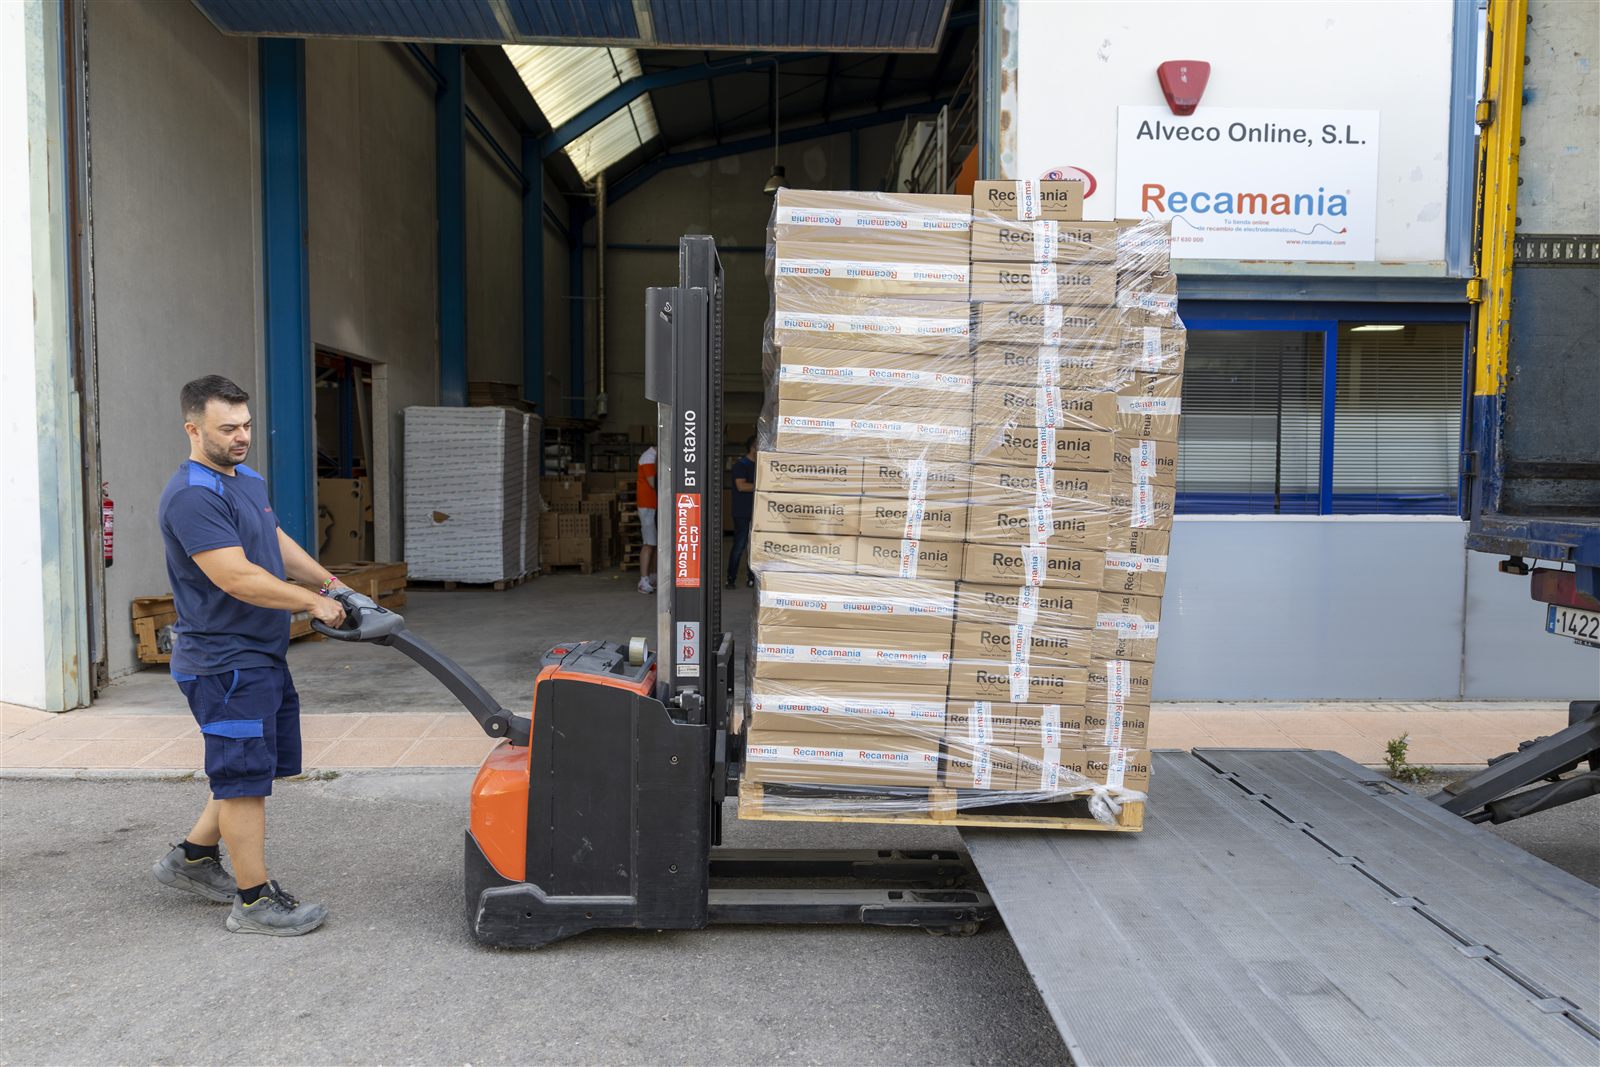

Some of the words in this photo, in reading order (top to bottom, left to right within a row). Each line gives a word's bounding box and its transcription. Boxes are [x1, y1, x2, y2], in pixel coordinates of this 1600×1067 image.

[1136, 120, 1220, 142] Alveco
[1228, 122, 1313, 147] Online,
[1321, 125, 1366, 145] S.L.
[1141, 183, 1348, 216] Recamania
[683, 410, 697, 463] staxio
[684, 467, 696, 486] BT
[770, 460, 847, 476] Recamania
[767, 500, 844, 516] Recamania
[677, 508, 689, 578] RECAMASA
[690, 527, 699, 560] RUTI
[763, 540, 841, 555] Recamania
[1562, 611, 1600, 640] 1422
[810, 647, 861, 658] Recamania
[793, 747, 844, 758] Recamania
[859, 750, 909, 761] Recamania
